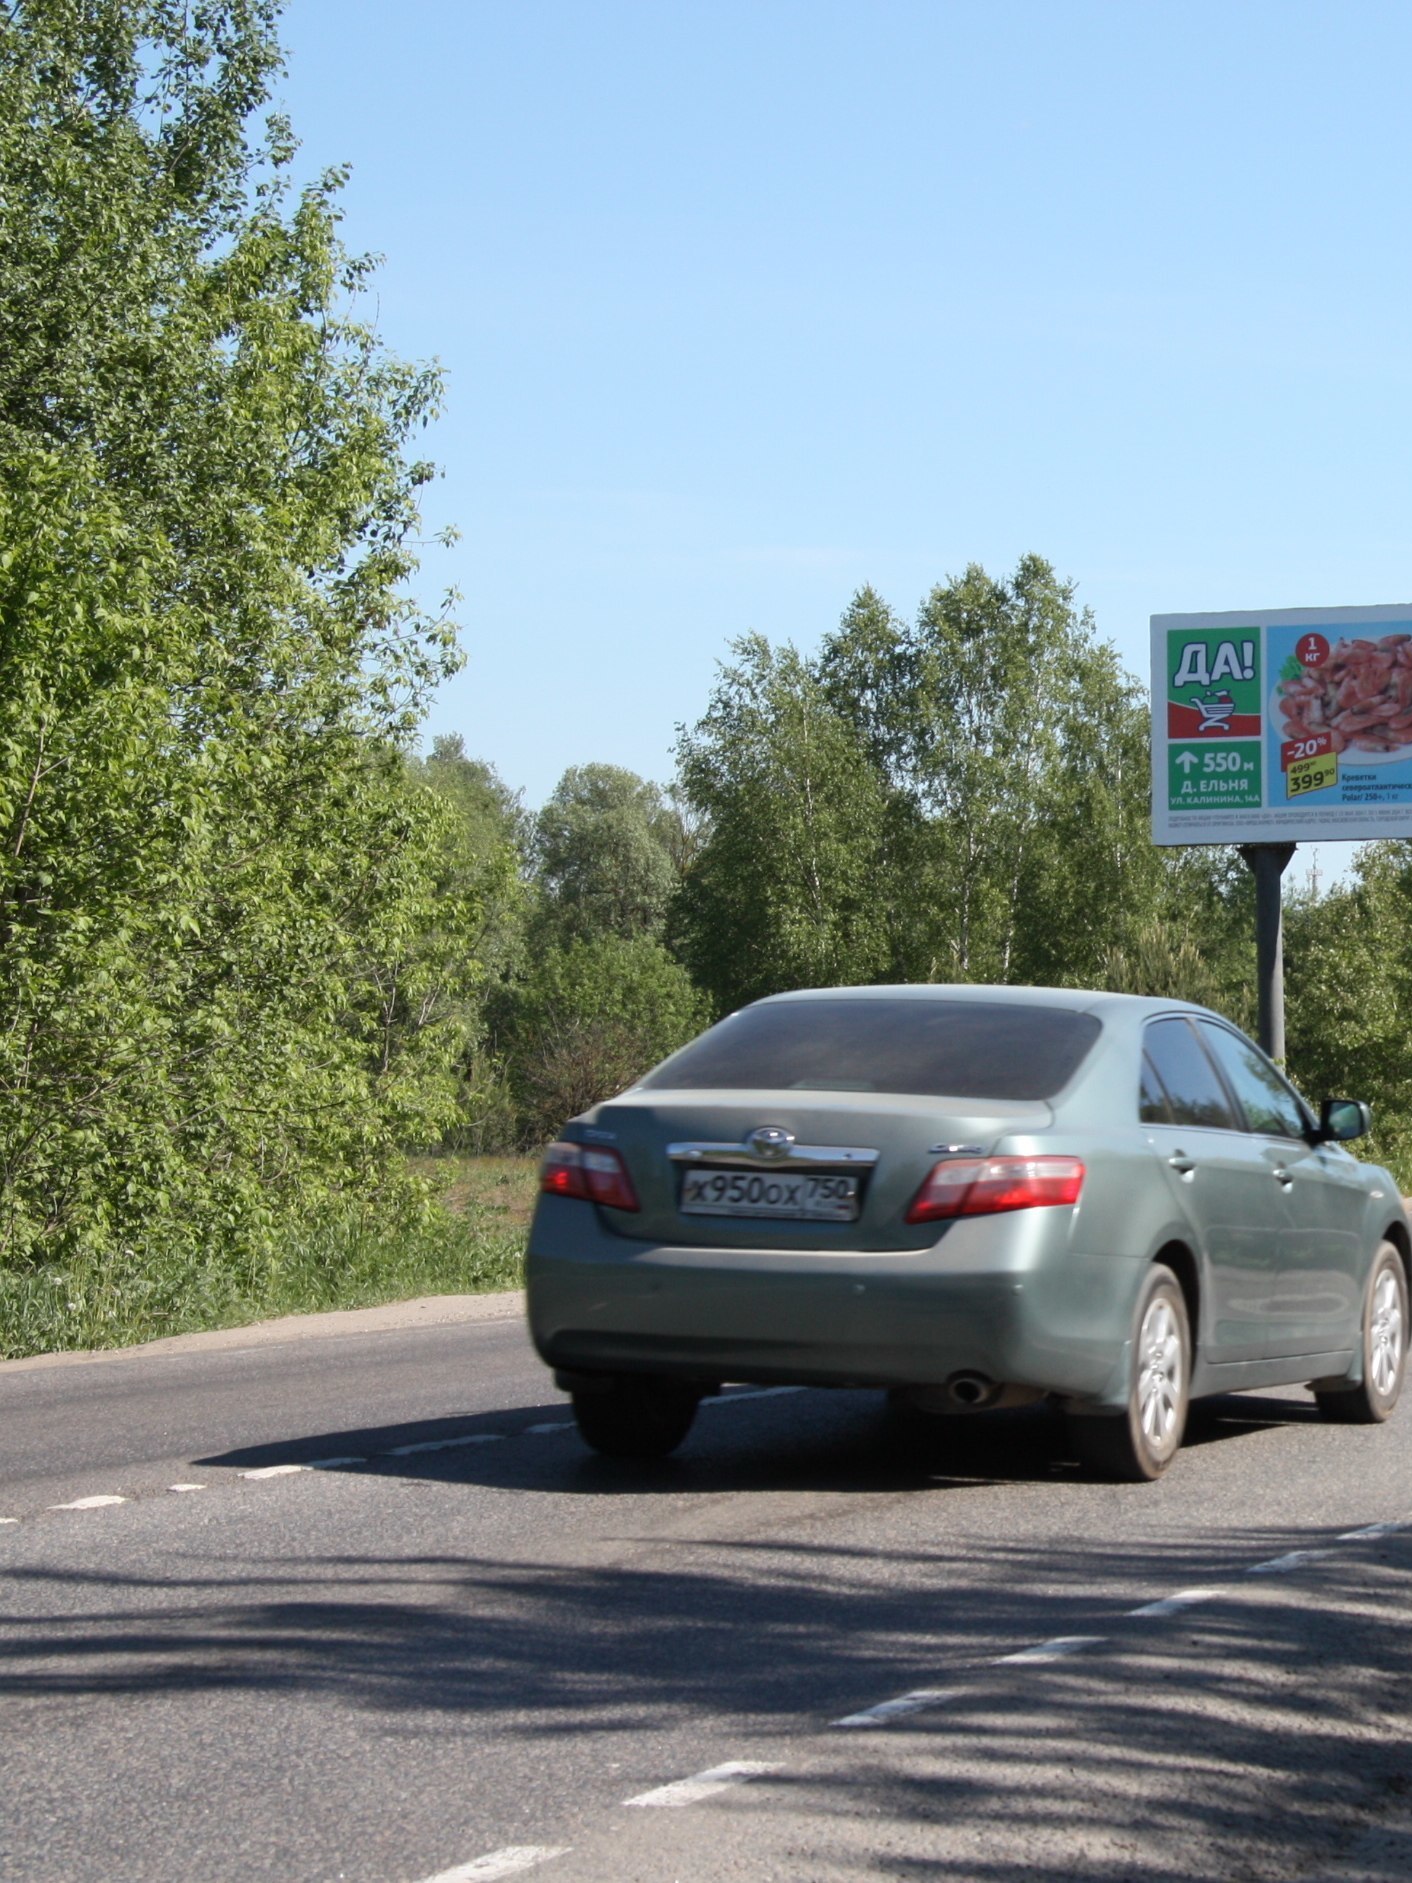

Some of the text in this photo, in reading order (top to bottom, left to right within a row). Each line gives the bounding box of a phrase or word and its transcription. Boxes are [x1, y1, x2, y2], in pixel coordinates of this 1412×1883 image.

[1308, 637, 1318, 650] 1
[1305, 652, 1321, 662] кг
[1173, 641, 1255, 688] ДА!
[1203, 752, 1241, 772] 550
[1181, 778, 1249, 794] Д. ЕЛЬНЯ
[1187, 794, 1244, 804] КАЛИНИНА,
